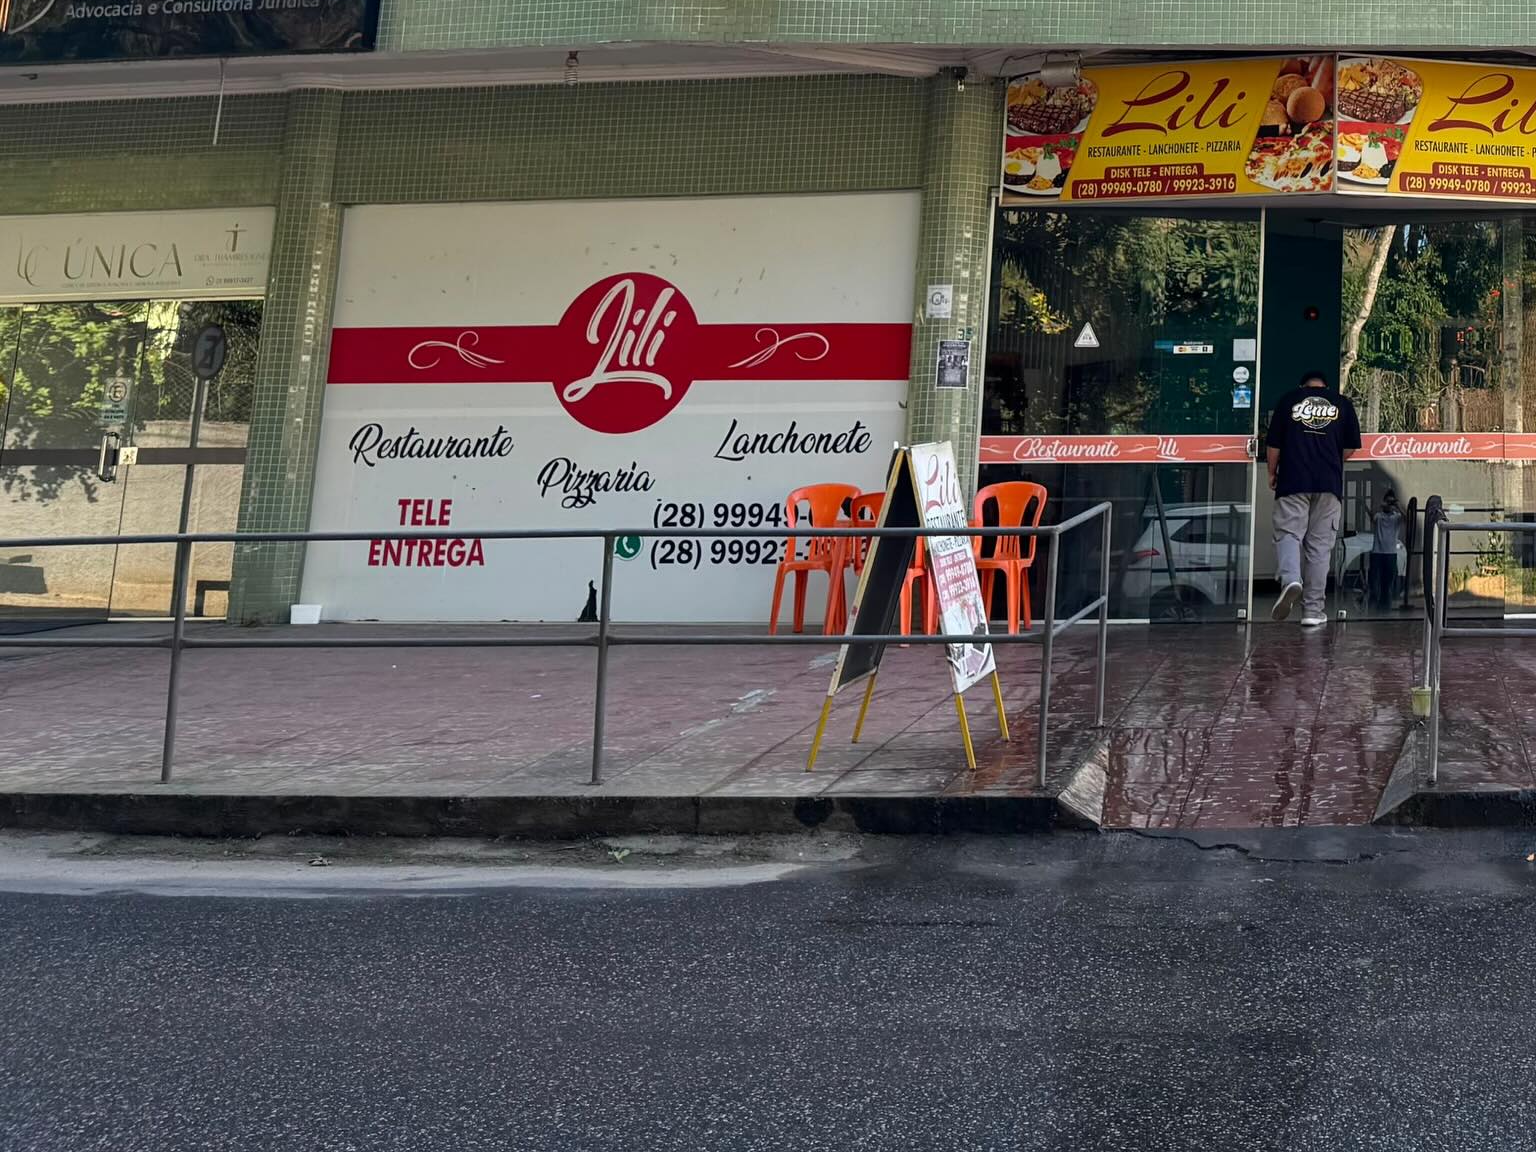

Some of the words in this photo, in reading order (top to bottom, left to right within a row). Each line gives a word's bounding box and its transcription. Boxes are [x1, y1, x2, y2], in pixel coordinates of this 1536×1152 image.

[65, 1, 142, 19] Advocacia
[147, 3, 158, 15] e
[1101, 70, 1249, 137] Lili
[1087, 144, 1142, 158] RESTAURANTE
[1148, 142, 1199, 156] LANCHONETE
[1206, 139, 1242, 153] PIZZARIA
[1414, 140, 1468, 154] RESTAURANTE
[1475, 144, 1526, 158] LANCHONETE
[1110, 167, 1132, 179] DISK
[1134, 166, 1151, 178] TELE
[1159, 165, 1199, 177] ENTREGA
[1438, 165, 1460, 176] DISK
[1461, 166, 1480, 177] TELE
[1487, 167, 1525, 178] ENTREGA
[1077, 182, 1098, 198] (28)
[1101, 180, 1162, 195] 99949-0780
[1173, 177, 1235, 192] 99923-3916
[1405, 178, 1427, 192] (28)
[1429, 179, 1491, 194] 99949-0780
[63, 237, 183, 280] ÚNICA
[563, 278, 678, 403] Lili
[349, 423, 514, 467] Restaurante
[714, 418, 872, 462] Lanchonete
[1013, 437, 1120, 461] Restaurante
[1370, 435, 1473, 458] Restaurante
[537, 457, 656, 509] Pizzaria
[397, 498, 453, 527] TELE
[653, 501, 705, 528] (28)
[367, 536, 485, 567] ENTREGA
[650, 538, 701, 570] (28)
